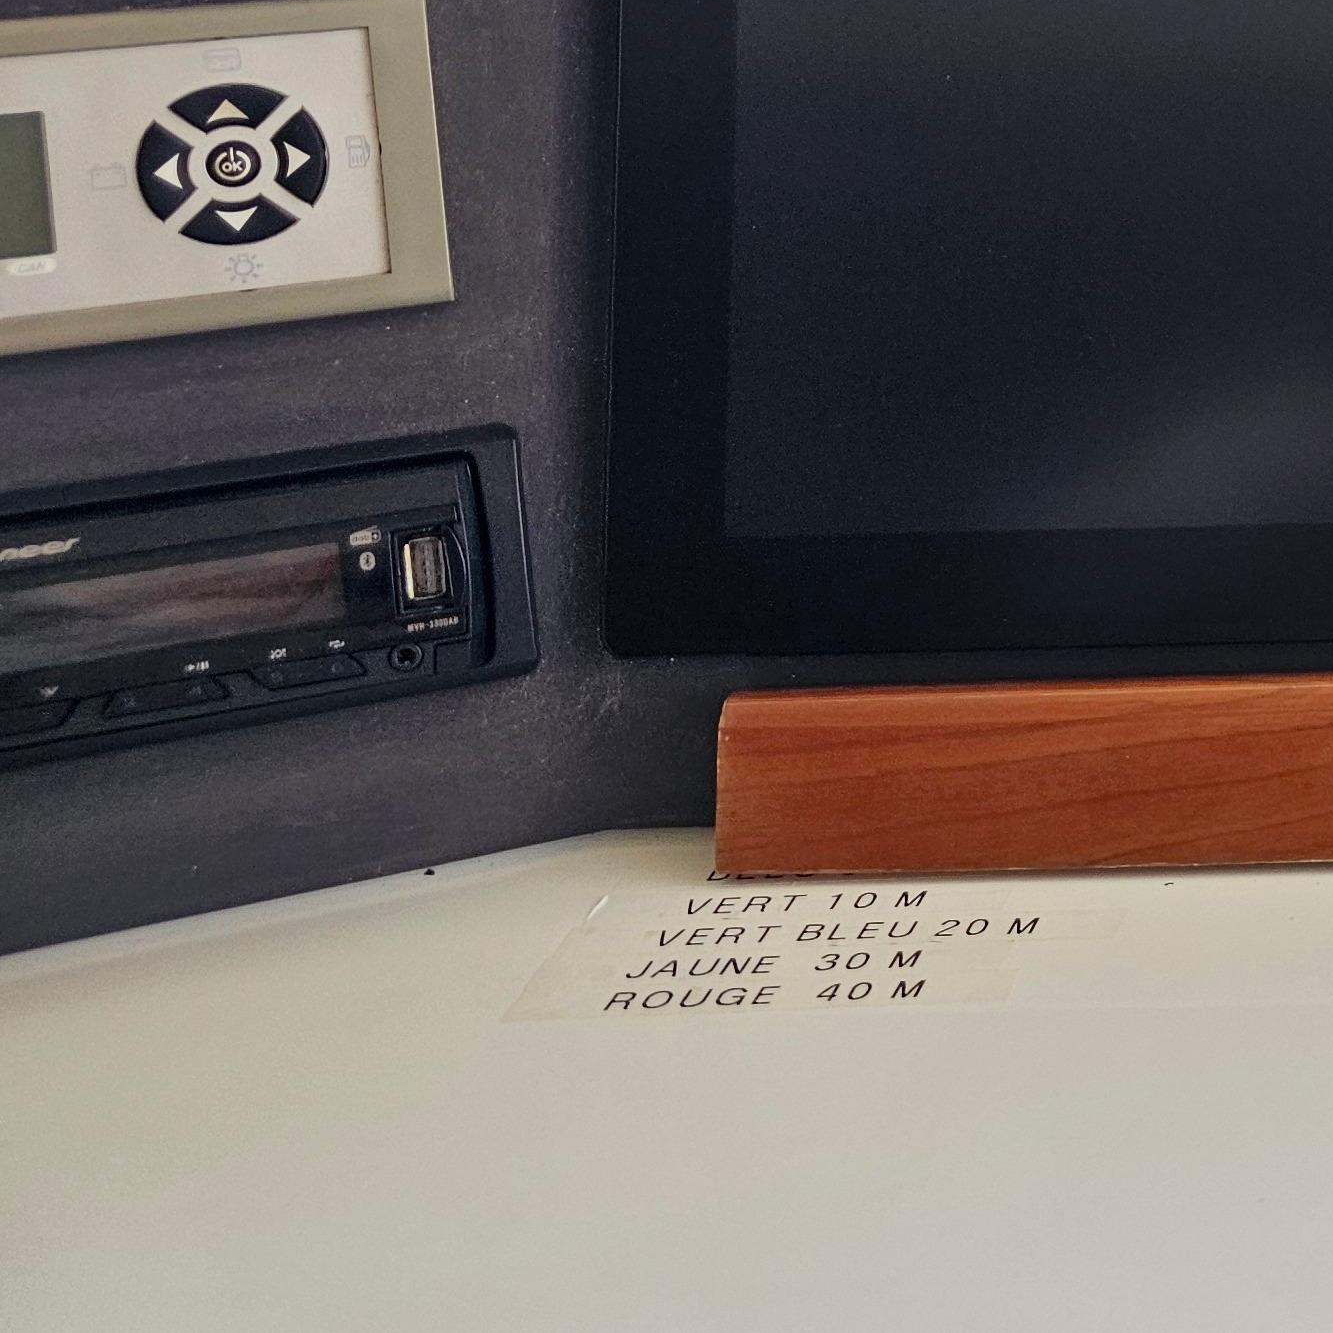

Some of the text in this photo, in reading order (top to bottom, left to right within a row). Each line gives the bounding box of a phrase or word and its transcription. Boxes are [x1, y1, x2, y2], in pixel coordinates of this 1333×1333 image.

[221, 160, 243, 173] OK
[687, 889, 929, 915] VERT 10 M
[659, 917, 1041, 947] VERT BLEU 20 M
[625, 949, 924, 979] JAUNE 30 M
[603, 979, 927, 1012] ROUGE 40 M
